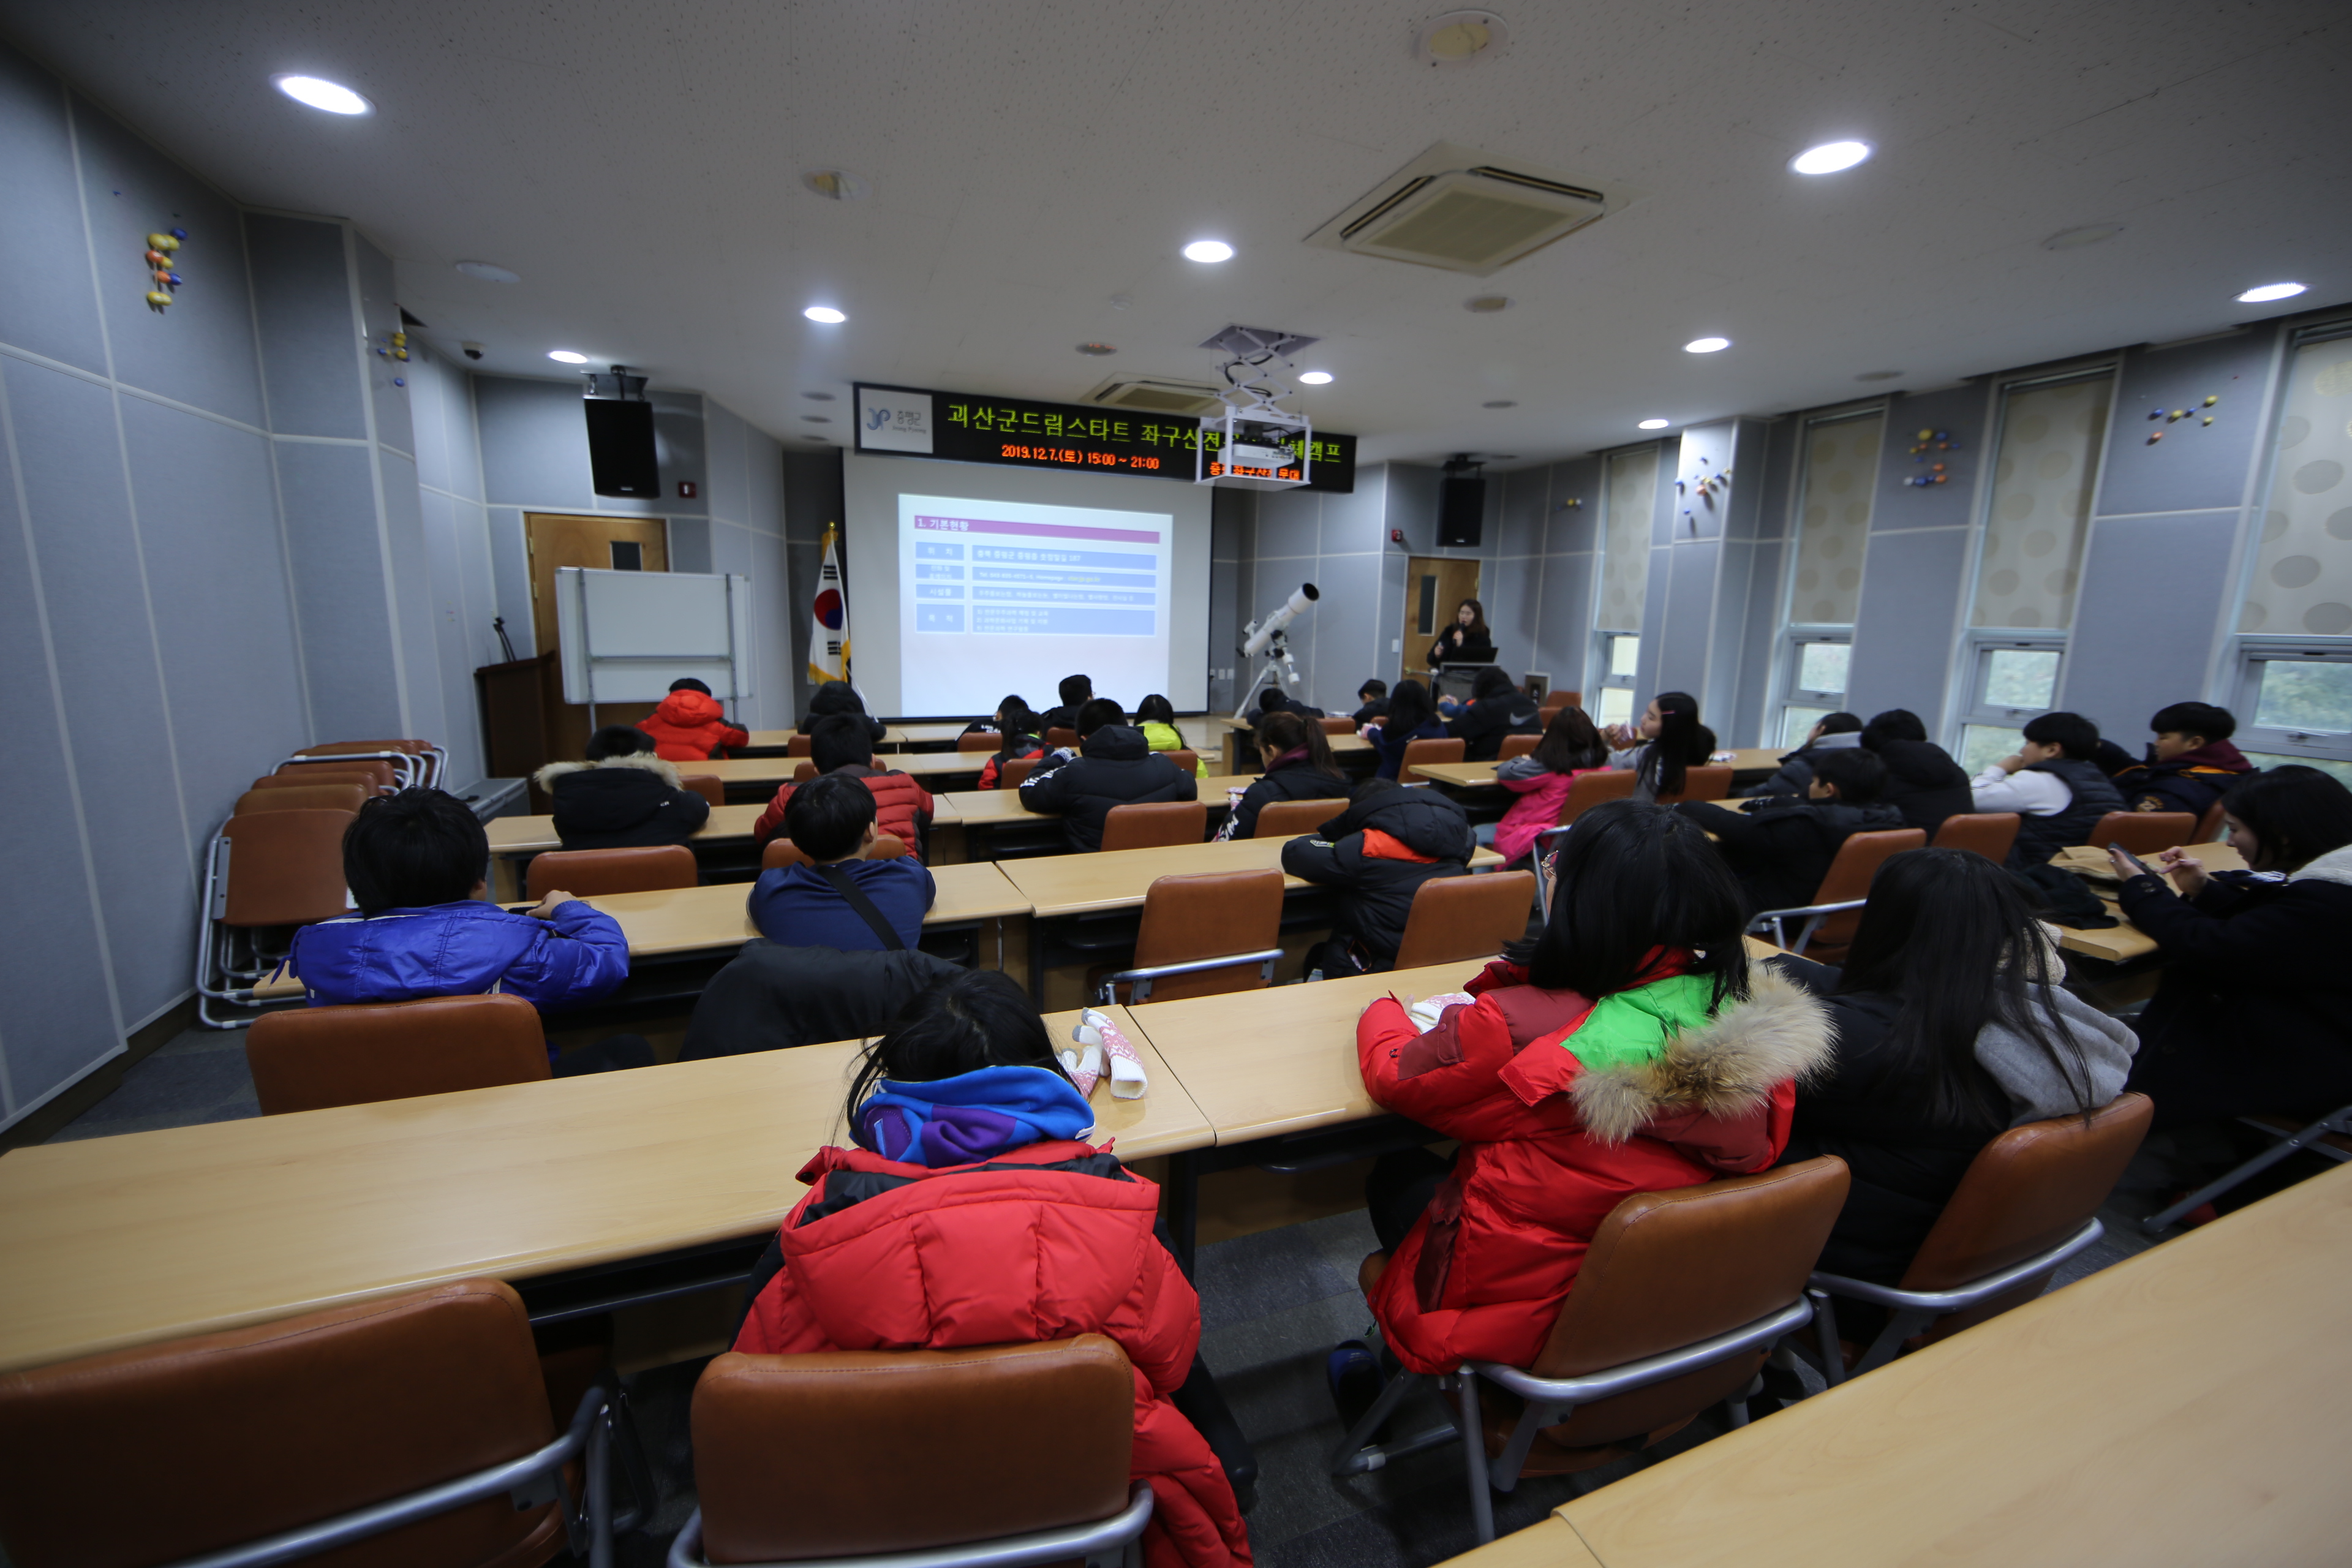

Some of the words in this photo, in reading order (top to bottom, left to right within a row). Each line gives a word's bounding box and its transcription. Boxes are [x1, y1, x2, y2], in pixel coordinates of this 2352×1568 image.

[897, 410, 922, 426] 증평군
[948, 404, 1131, 442] 괴산군드림스타트
[1001, 443, 1083, 464] 2019.12.7.(토)
[1087, 452, 1116, 466] 15:00
[1130, 456, 1160, 470] 21:00
[918, 518, 927, 527] 1.
[929, 519, 970, 532] 기본현황
